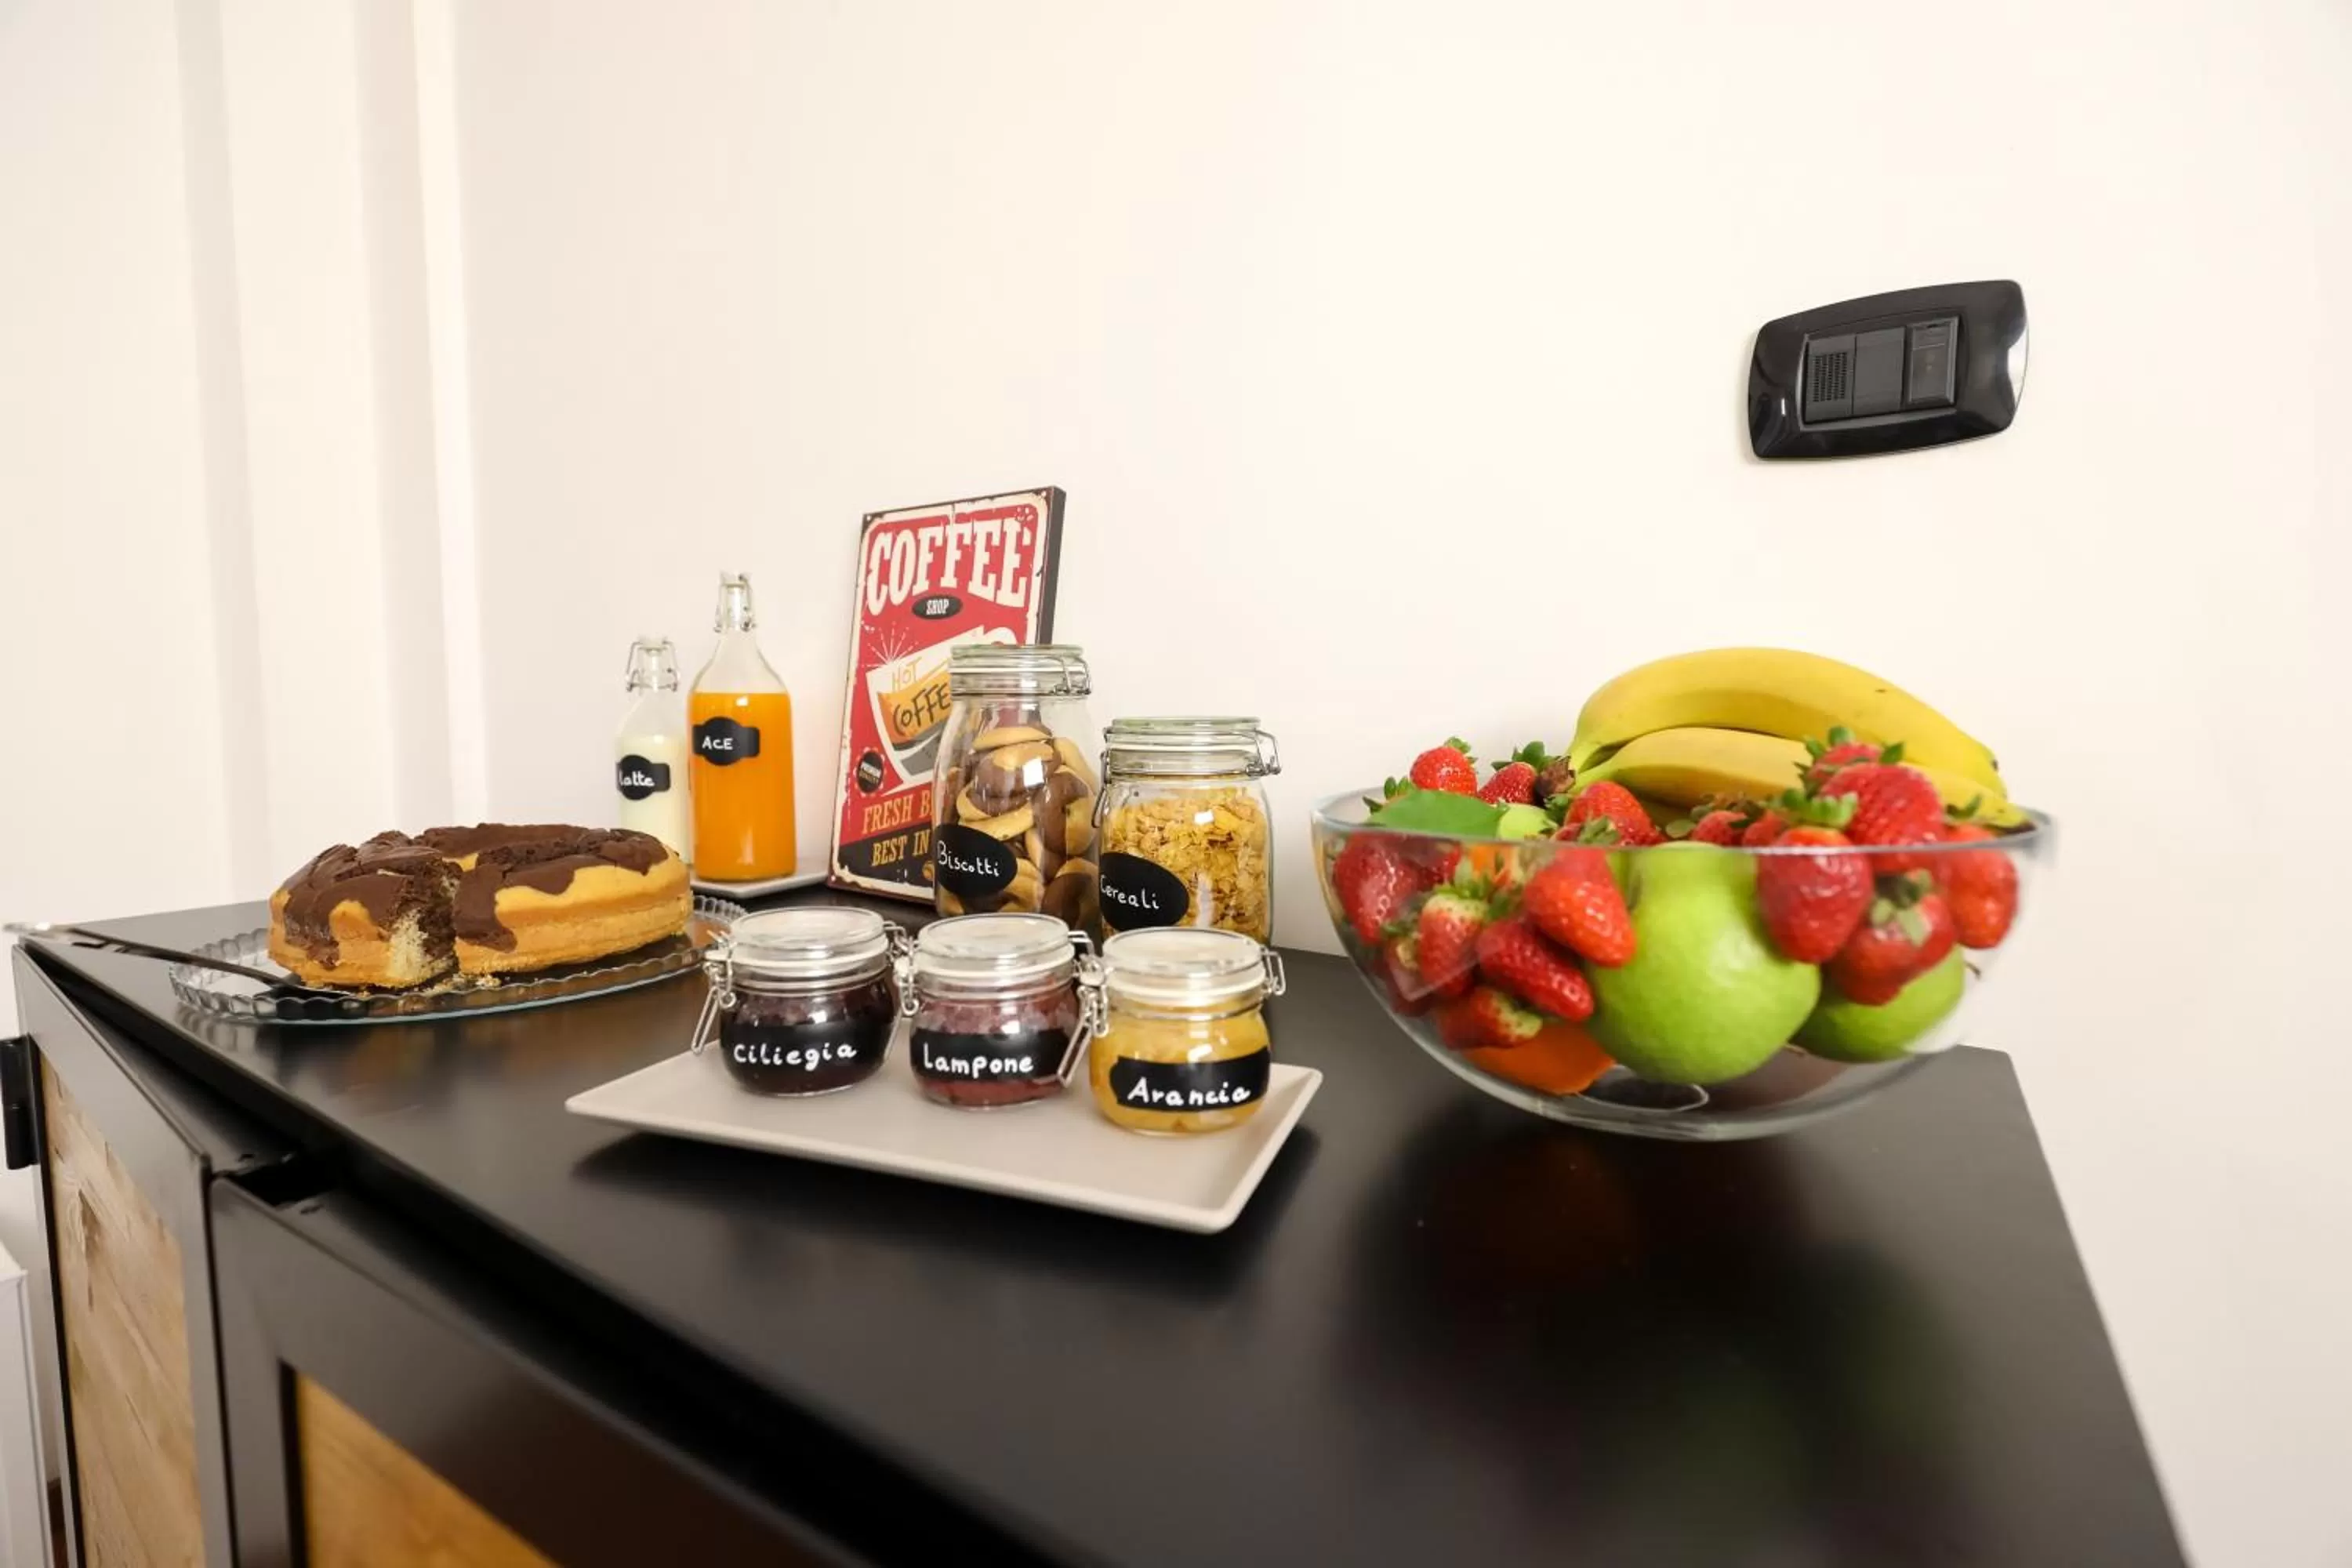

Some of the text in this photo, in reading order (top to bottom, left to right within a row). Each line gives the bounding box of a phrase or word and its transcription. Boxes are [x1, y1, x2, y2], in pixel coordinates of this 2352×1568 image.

[867, 518, 1030, 615] COFFEE
[926, 598, 949, 615] SHOP
[891, 656, 923, 693] HOT
[702, 735, 735, 750] ACE
[862, 793, 914, 835] FRESH
[871, 829, 931, 867] BEST IN
[937, 840, 1000, 877] Biscotti
[1100, 874, 1160, 909] Cereali
[733, 1041, 858, 1071] Ciliegia
[1127, 1076, 1251, 1107] Arancia
